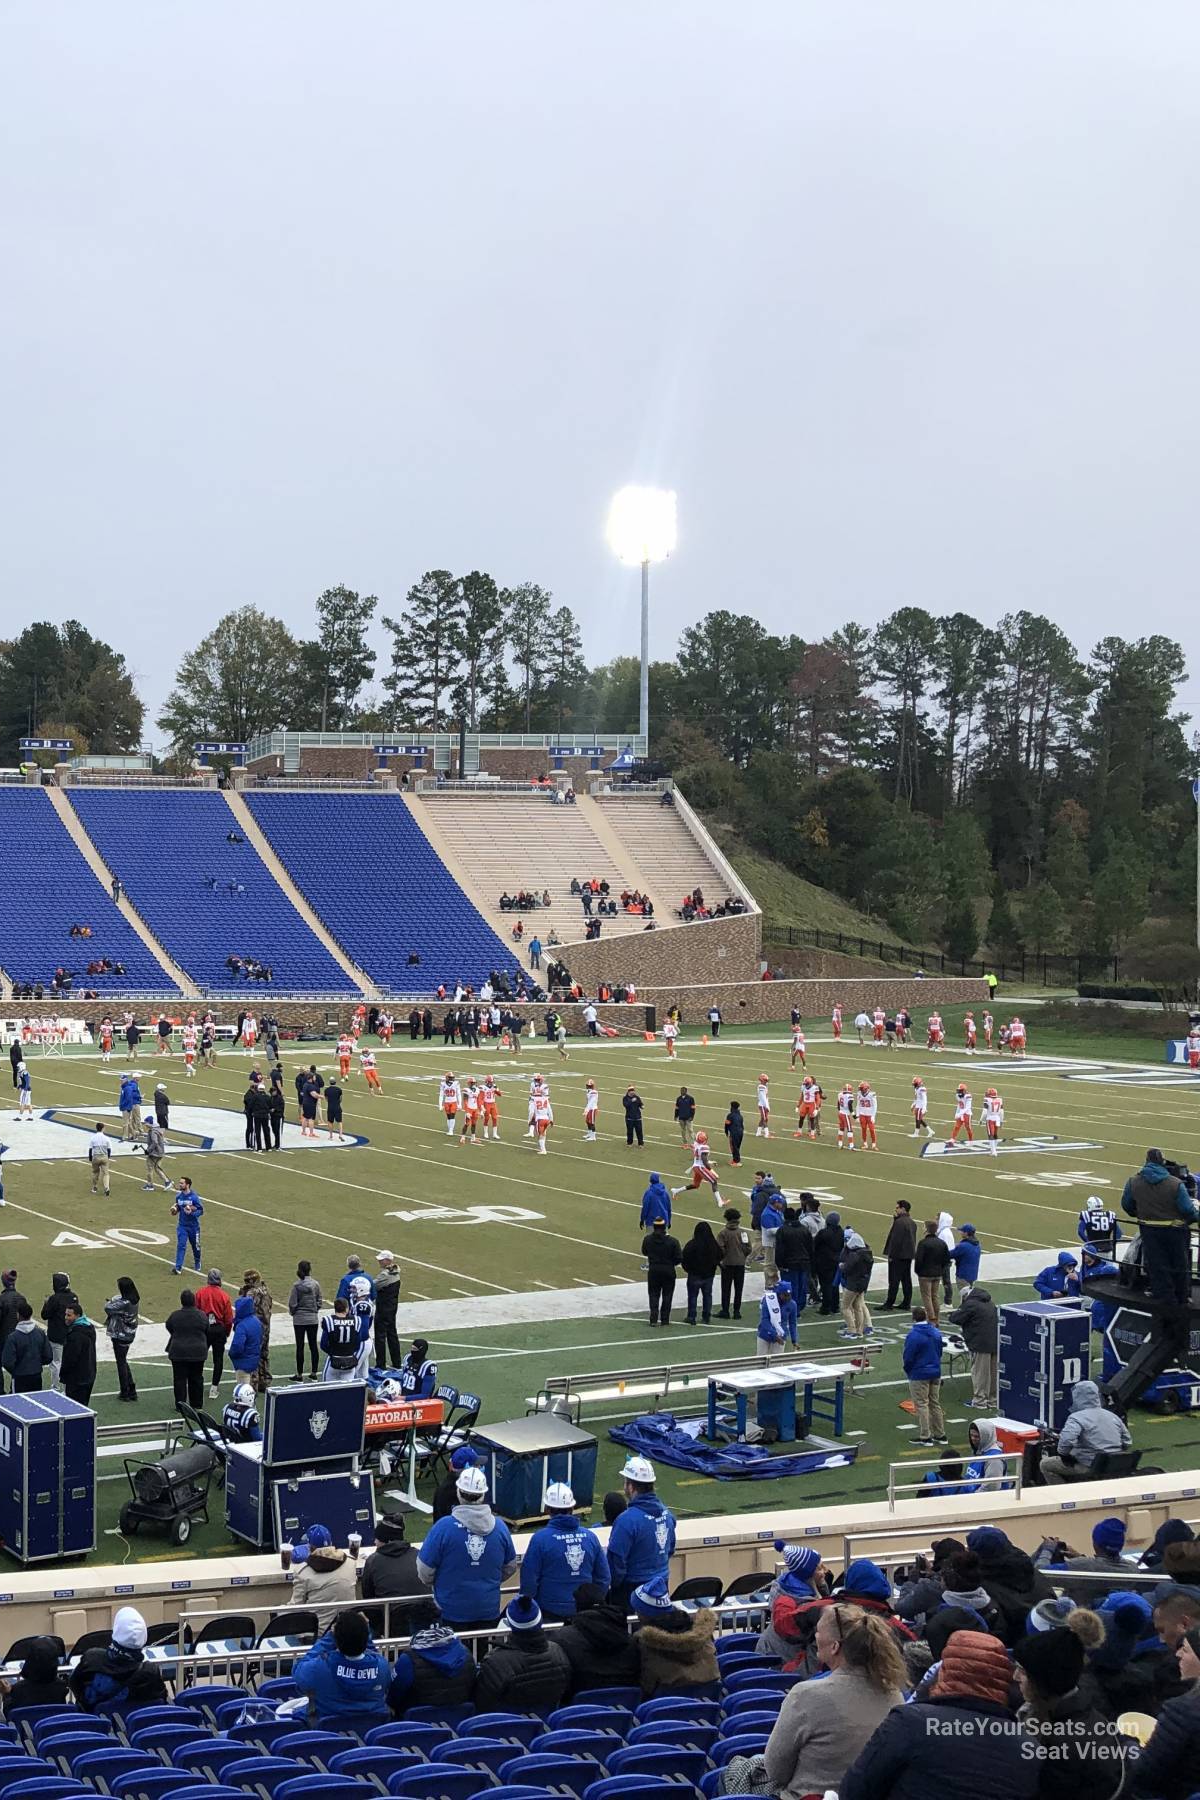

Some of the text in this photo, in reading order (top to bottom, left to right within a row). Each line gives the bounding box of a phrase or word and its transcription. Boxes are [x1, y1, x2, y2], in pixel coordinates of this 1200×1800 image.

[1092, 1216, 1109, 1231] 58
[50, 1228, 170, 1250] 40
[339, 1327, 351, 1344] 11
[1062, 1358, 1082, 1385] D
[438, 1386, 455, 1399] DUKE
[460, 1394, 477, 1409] DUKE
[336, 1664, 356, 1679] BLUE
